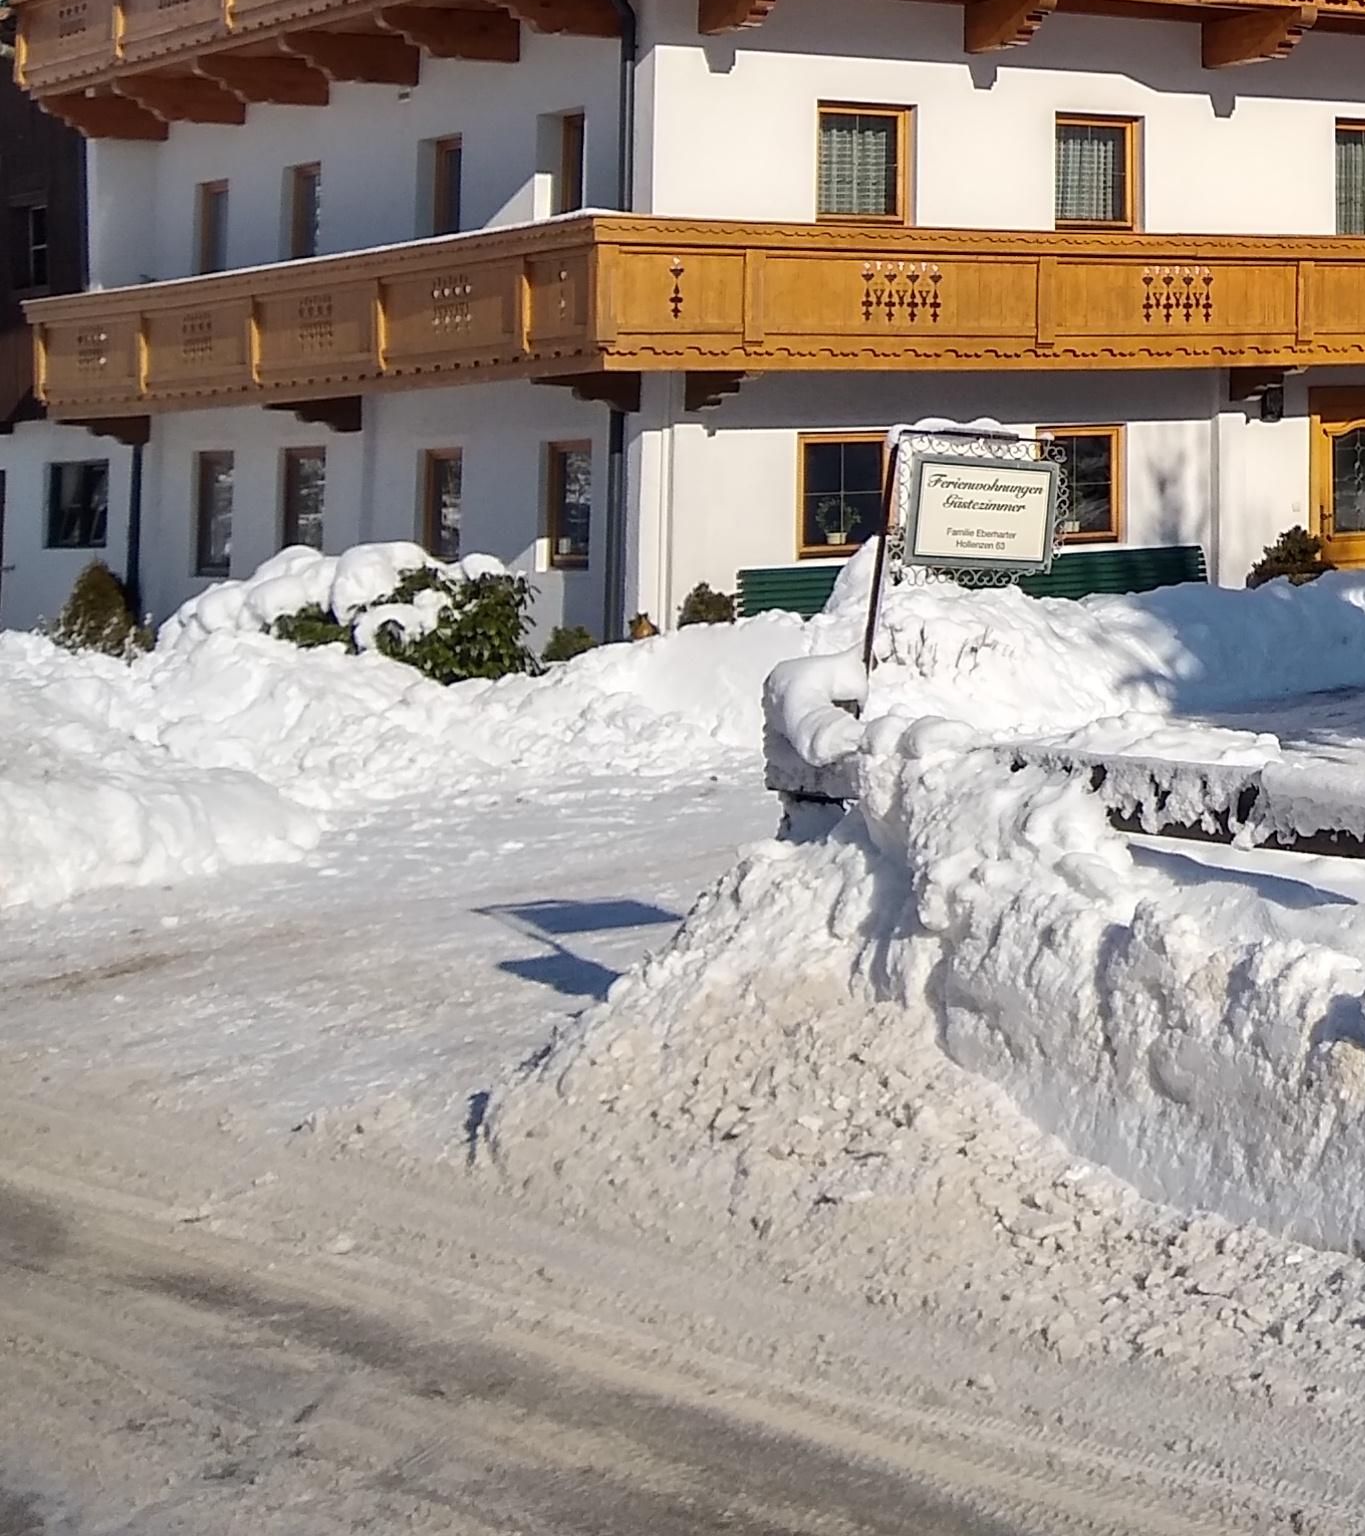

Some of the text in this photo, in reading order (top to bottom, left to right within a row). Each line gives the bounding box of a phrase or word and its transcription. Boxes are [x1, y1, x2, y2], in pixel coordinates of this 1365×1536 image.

[927, 473, 1043, 498] Ferienwohnungen
[942, 494, 1026, 512] Gästezimmer
[946, 527, 1017, 539] Familie Eberharter
